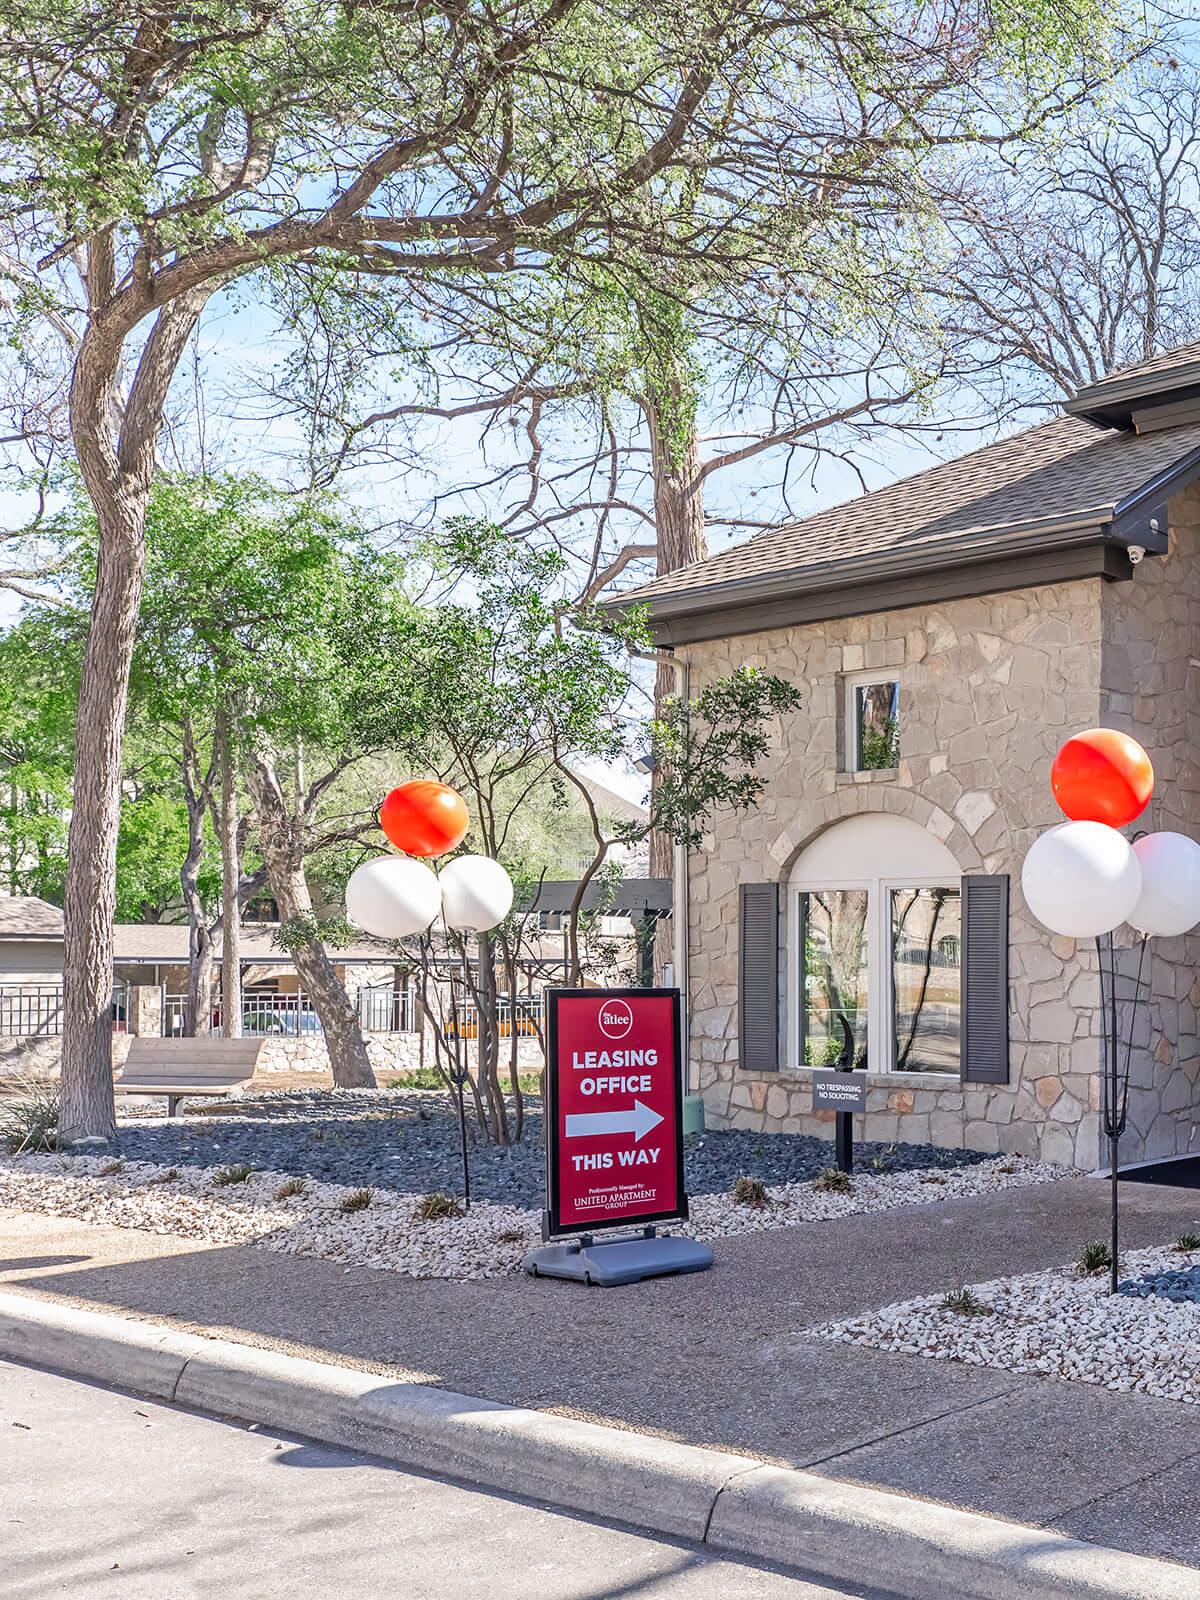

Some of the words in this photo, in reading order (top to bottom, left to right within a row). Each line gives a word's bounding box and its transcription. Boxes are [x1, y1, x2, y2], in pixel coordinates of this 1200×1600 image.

[603, 1014, 630, 1025] atlee
[572, 1049, 658, 1069] LEASING
[580, 1075, 652, 1096] OFFICE
[571, 1153, 614, 1171] THIS
[618, 1147, 661, 1167] WAY
[574, 1195, 608, 1207] UNITED
[608, 1189, 657, 1203] APARTMENT
[604, 1201, 628, 1210] GROUP
